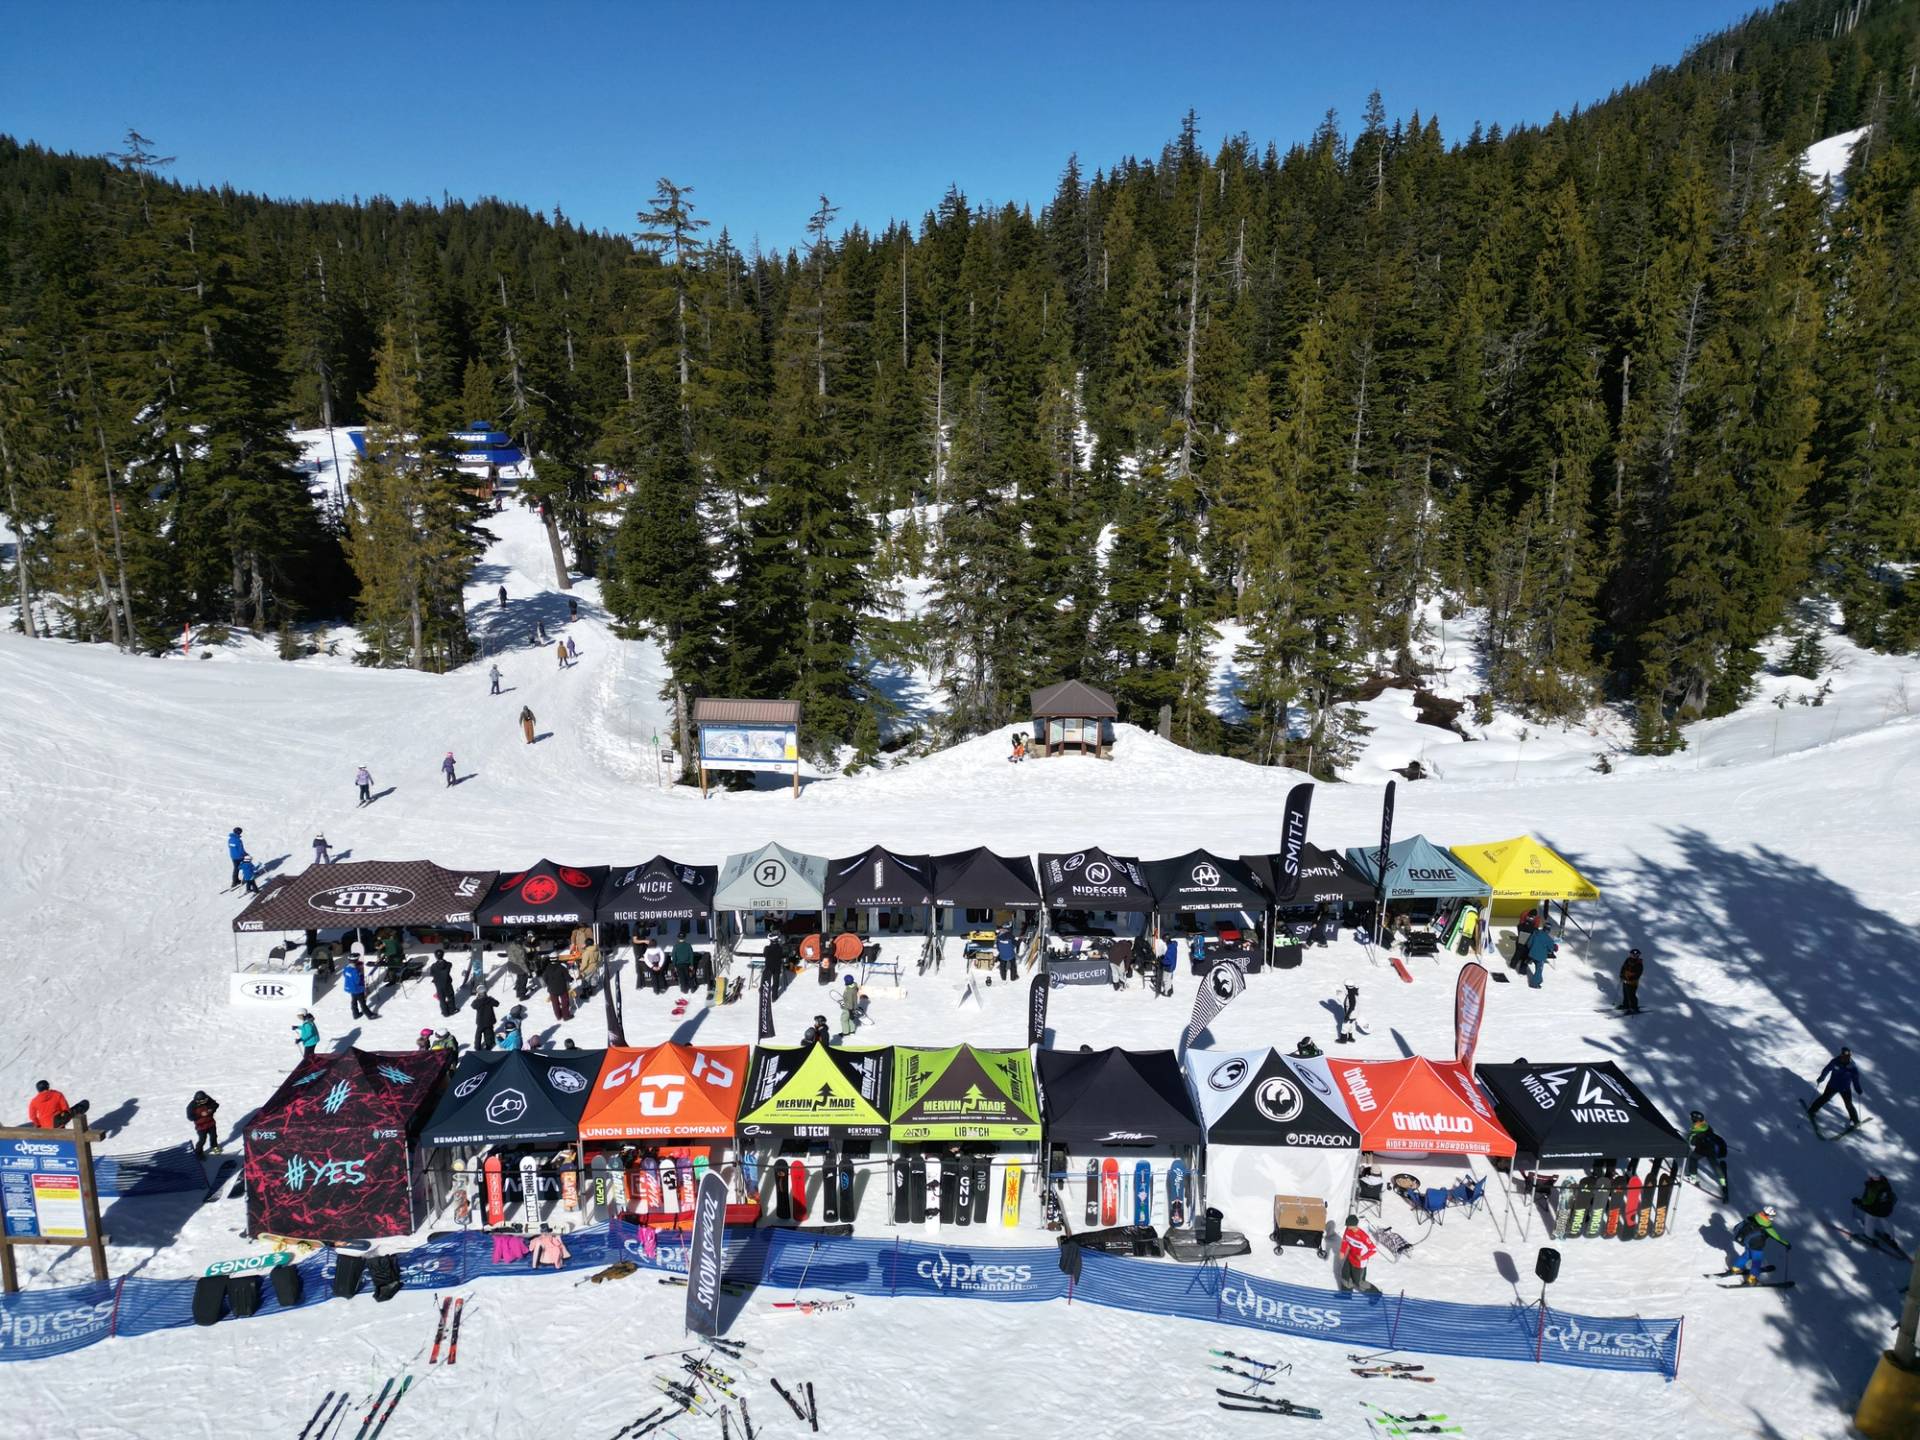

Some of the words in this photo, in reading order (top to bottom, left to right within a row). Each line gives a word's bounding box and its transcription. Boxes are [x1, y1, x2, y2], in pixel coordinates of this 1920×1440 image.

[1285, 810, 1304, 876] SMITH
[1301, 868, 1338, 878] SMITH
[1408, 868, 1457, 879] ROME
[347, 886, 402, 894] BOARDROOM
[639, 882, 673, 893] NICHE
[1072, 886, 1127, 894] NIDECKER
[1314, 893, 1343, 902] SMITH
[445, 912, 470, 923] VANS
[503, 915, 535, 924] NEVER
[537, 914, 579, 923] SUMMER
[614, 912, 638, 920] NICHE
[640, 910, 693, 919] SNOWBOARDS
[237, 920, 264, 930] VANS
[1296, 924, 1334, 934] SMH
[1062, 969, 1107, 980] NIDECKER
[1343, 1066, 1378, 1113] thirtytwo
[1520, 1073, 1556, 1110] WIRED
[776, 1099, 812, 1108] MERVIN
[829, 1098, 855, 1108] MADE
[923, 1101, 961, 1111] MERVIN
[978, 1101, 1006, 1111] MADE
[1571, 1108, 1630, 1123] WIRED
[1392, 1111, 1473, 1134] thirtytwo
[586, 1128, 622, 1136] UNION
[625, 1127, 671, 1135] BINDING
[673, 1126, 727, 1135] COMPANY
[793, 1126, 807, 1136] LIB
[808, 1126, 830, 1136] TECH
[954, 1127, 967, 1137] LIB
[1299, 1134, 1352, 1146] DRAGON
[1386, 1140, 1407, 1149] RIDER
[1408, 1140, 1433, 1150] DRIVEN
[1436, 1141, 1491, 1153] SNOWBOARDING
[977, 1171, 986, 1191] GNU
[959, 1176, 970, 1207] GNU
[916, 1250, 1032, 1290] cypress
[1221, 1279, 1342, 1328] cypress
